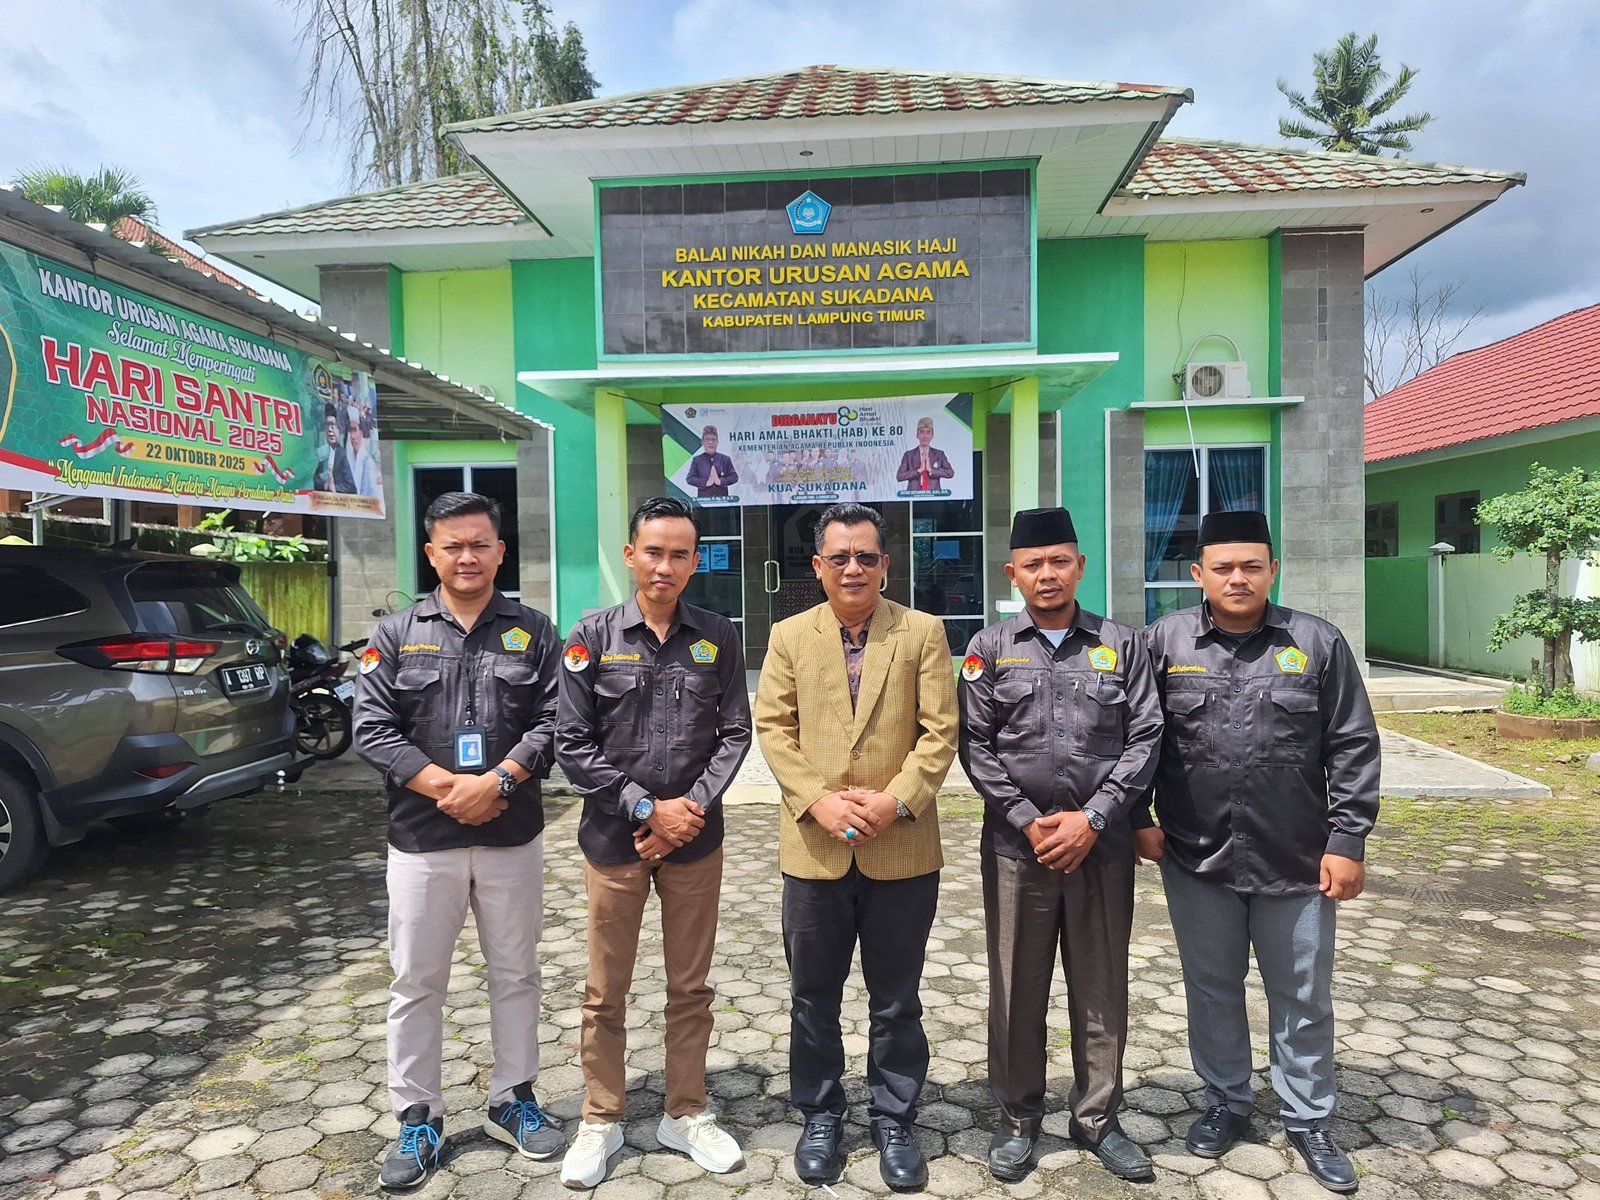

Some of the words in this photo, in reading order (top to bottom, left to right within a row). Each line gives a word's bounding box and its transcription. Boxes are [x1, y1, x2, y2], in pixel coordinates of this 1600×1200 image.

[676, 247, 727, 262] BALAI
[732, 245, 785, 260] NIKAH
[791, 243, 827, 259] DAN
[832, 240, 911, 257] MANASIK
[917, 238, 957, 254] HAJI
[661, 267, 762, 288] KANTOR
[769, 265, 871, 284] URUSAN
[877, 260, 970, 280] AGAMA
[694, 290, 815, 309] KECAMATAN
[820, 286, 934, 305] SUKADANA
[39, 268, 114, 316] KANTOR
[116, 295, 180, 337] URUSAN
[181, 319, 230, 353] AGAMA
[228, 335, 293, 372] SUKADANA
[703, 314, 794, 328] KABUPATEN
[798, 311, 874, 325] LAMPUNG
[877, 309, 926, 322] TIMUR
[107, 321, 168, 358] Selamat
[170, 340, 256, 384] Memperingati
[40, 335, 164, 406] HARI
[170, 371, 304, 436] SANTRI
[86, 395, 222, 445] NASIONAL
[228, 426, 284, 455] 2025
[771, 412, 837, 427] DIRGAHAYU
[729, 431, 755, 442] HARI
[759, 430, 789, 441] AMAL
[793, 428, 833, 440] BHAKTI
[837, 426, 868, 439] (HAB)
[871, 426, 886, 437] KE
[889, 425, 903, 436] 80
[738, 443, 788, 452] KEMENTERIAN
[790, 442, 816, 450] AGAMA
[818, 441, 854, 449] REPUBLIK
[855, 439, 895, 448] INDONESIA
[146, 443, 162, 459] 22
[164, 446, 217, 468] OKTOBER
[219, 454, 245, 472] 2025
[116, 465, 162, 491] Indonesia
[768, 483, 793, 493] KUA
[797, 481, 867, 492] SUKADANA
